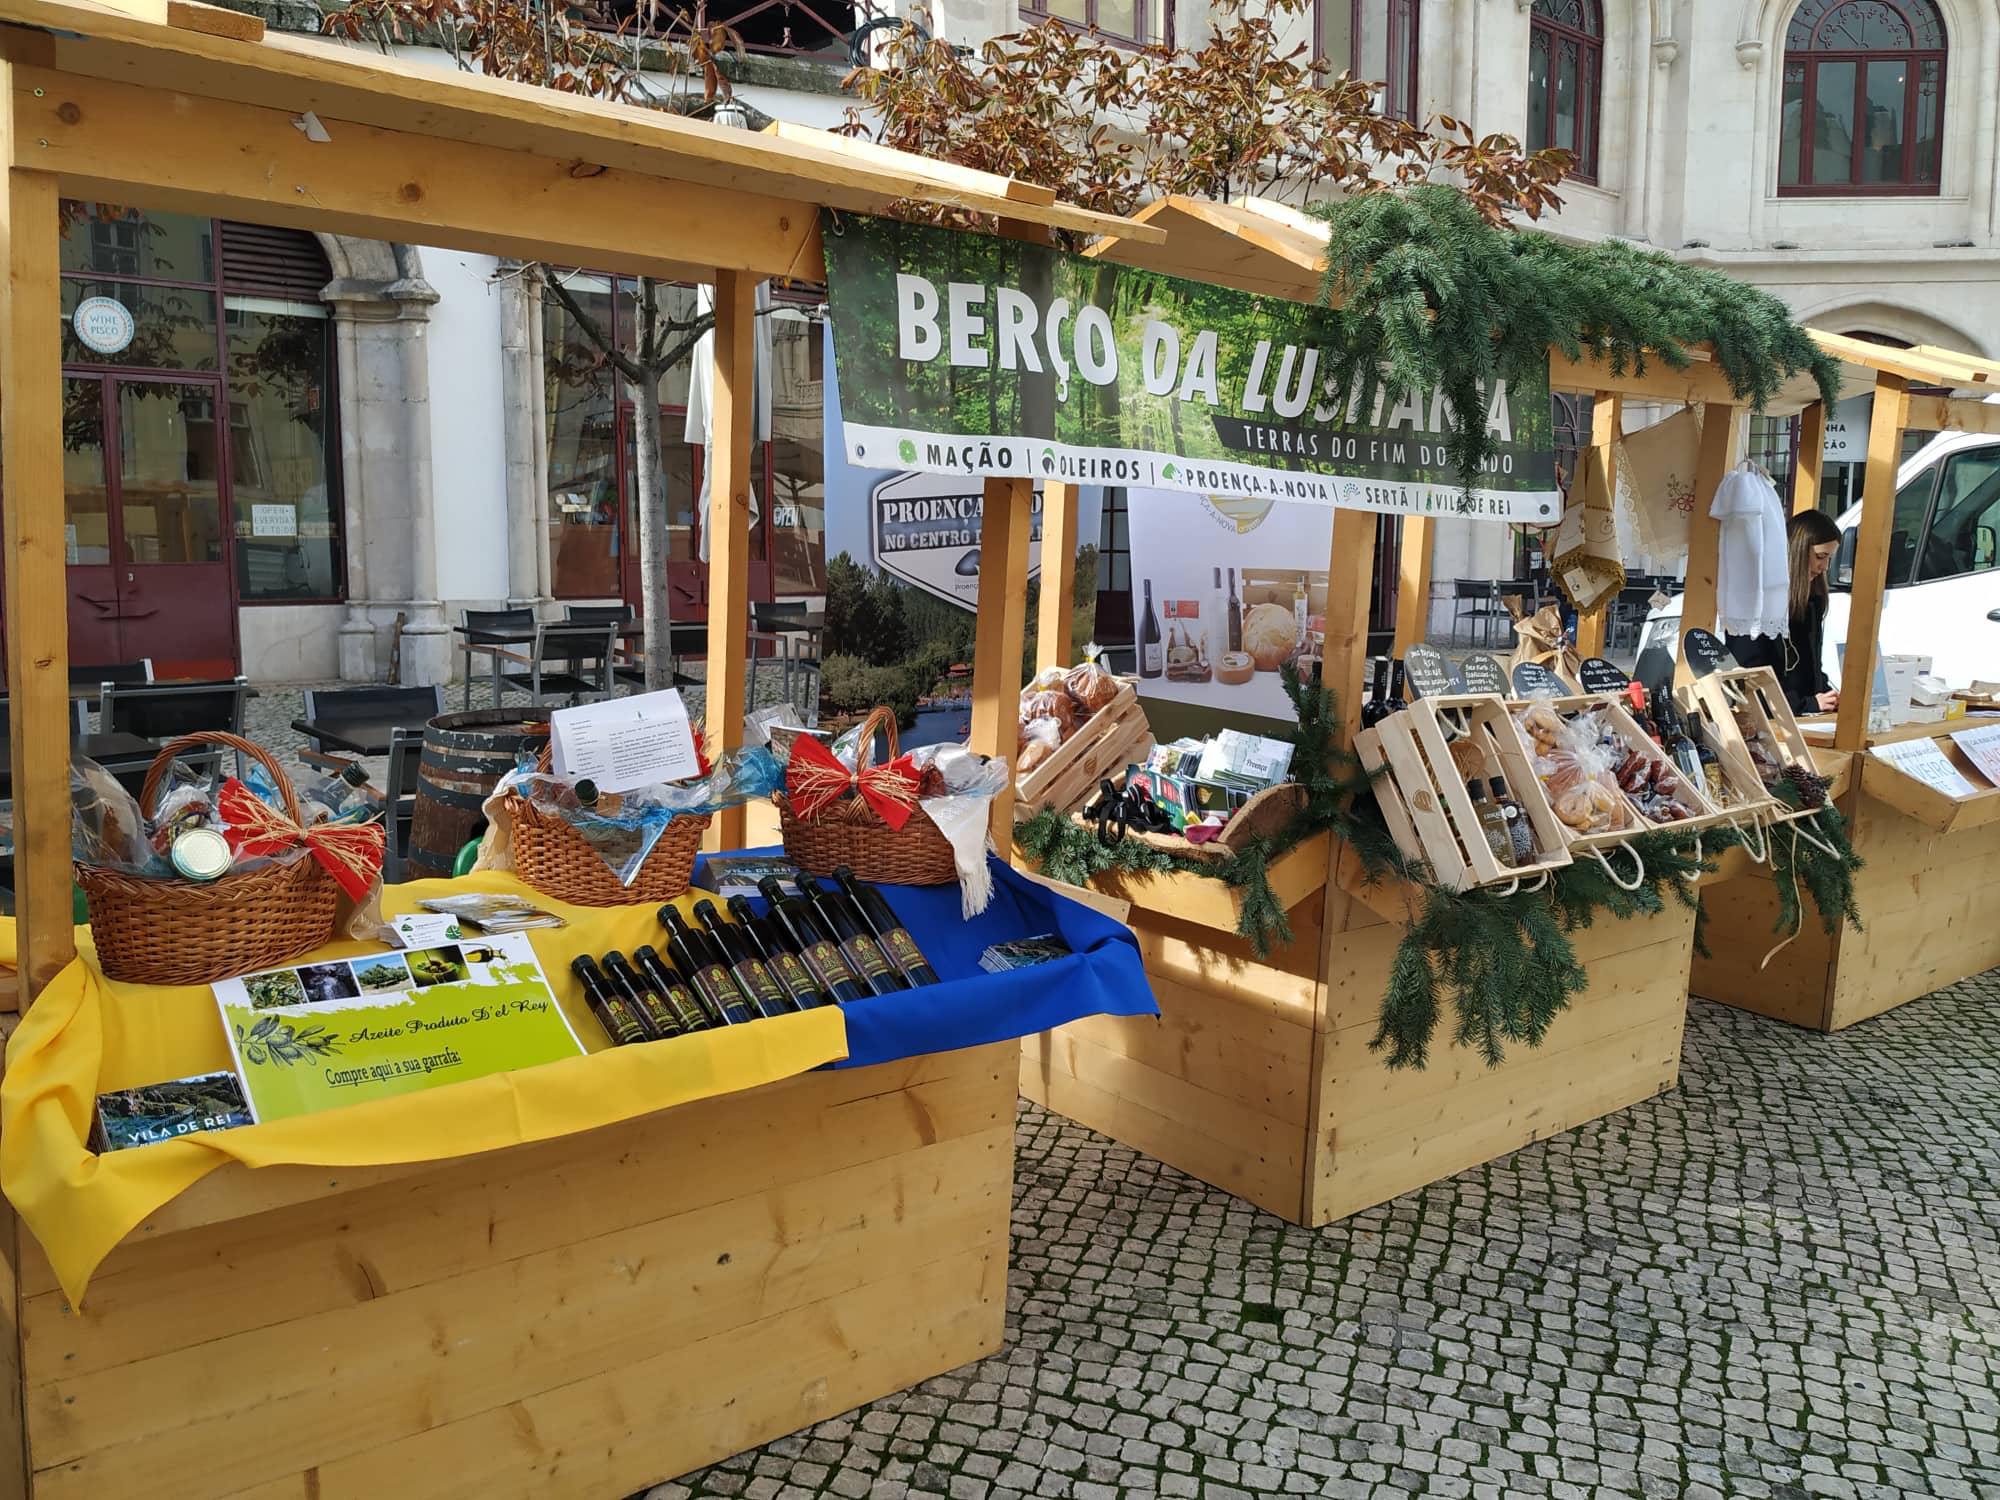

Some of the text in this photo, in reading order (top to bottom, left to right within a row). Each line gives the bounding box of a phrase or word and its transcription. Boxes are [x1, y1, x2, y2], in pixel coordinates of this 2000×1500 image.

[896, 273, 1119, 404] BERÇO
[1143, 319, 1219, 405] DA
[1243, 425, 1318, 455] TERRAS
[1332, 437, 1355, 460] DO
[1371, 441, 1406, 465] FIM
[1421, 446, 1446, 467] DO
[927, 442, 1013, 473] MAÇÃO
[1060, 456, 1140, 481] OLEIROS
[1186, 468, 1328, 501] PROENÇA-A-NOVA
[1366, 486, 1409, 507] SERTÃ
[1489, 499, 1511, 515] REI
[884, 533, 906, 550] NO
[909, 529, 970, 549] CENTRO
[349, 1027, 404, 1043] Azeite
[406, 1016, 470, 1034] Produto
[510, 999, 548, 1013] Rey
[325, 1047, 461, 1087] Compre aqui a sua garrafa:
[128, 1128, 172, 1142] VILA
[177, 1121, 199, 1134] DE
[204, 1114, 232, 1127] REI
